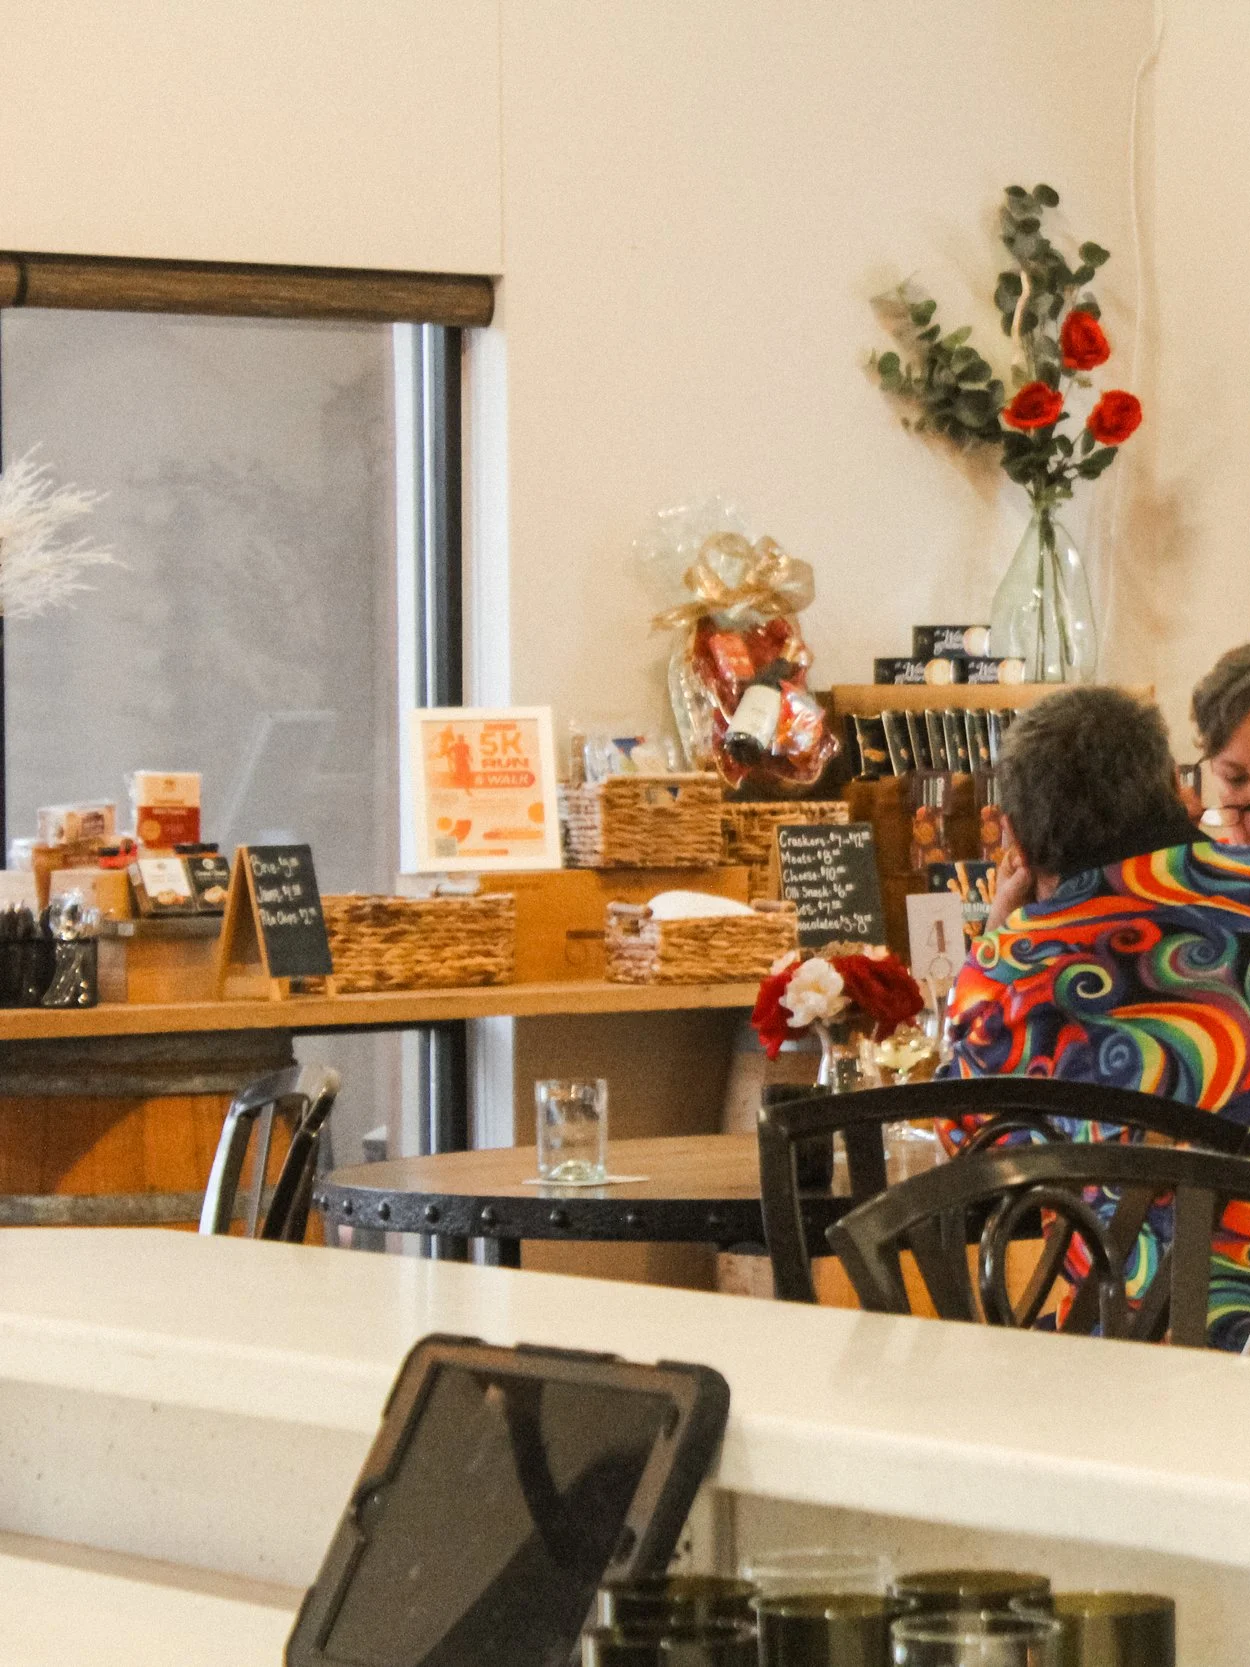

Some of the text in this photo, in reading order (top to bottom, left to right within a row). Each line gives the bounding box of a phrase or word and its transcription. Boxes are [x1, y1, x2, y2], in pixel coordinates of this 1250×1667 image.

[480, 731, 523, 756] 5K
[481, 758, 529, 768] RUN
[487, 774, 529, 785] WALK
